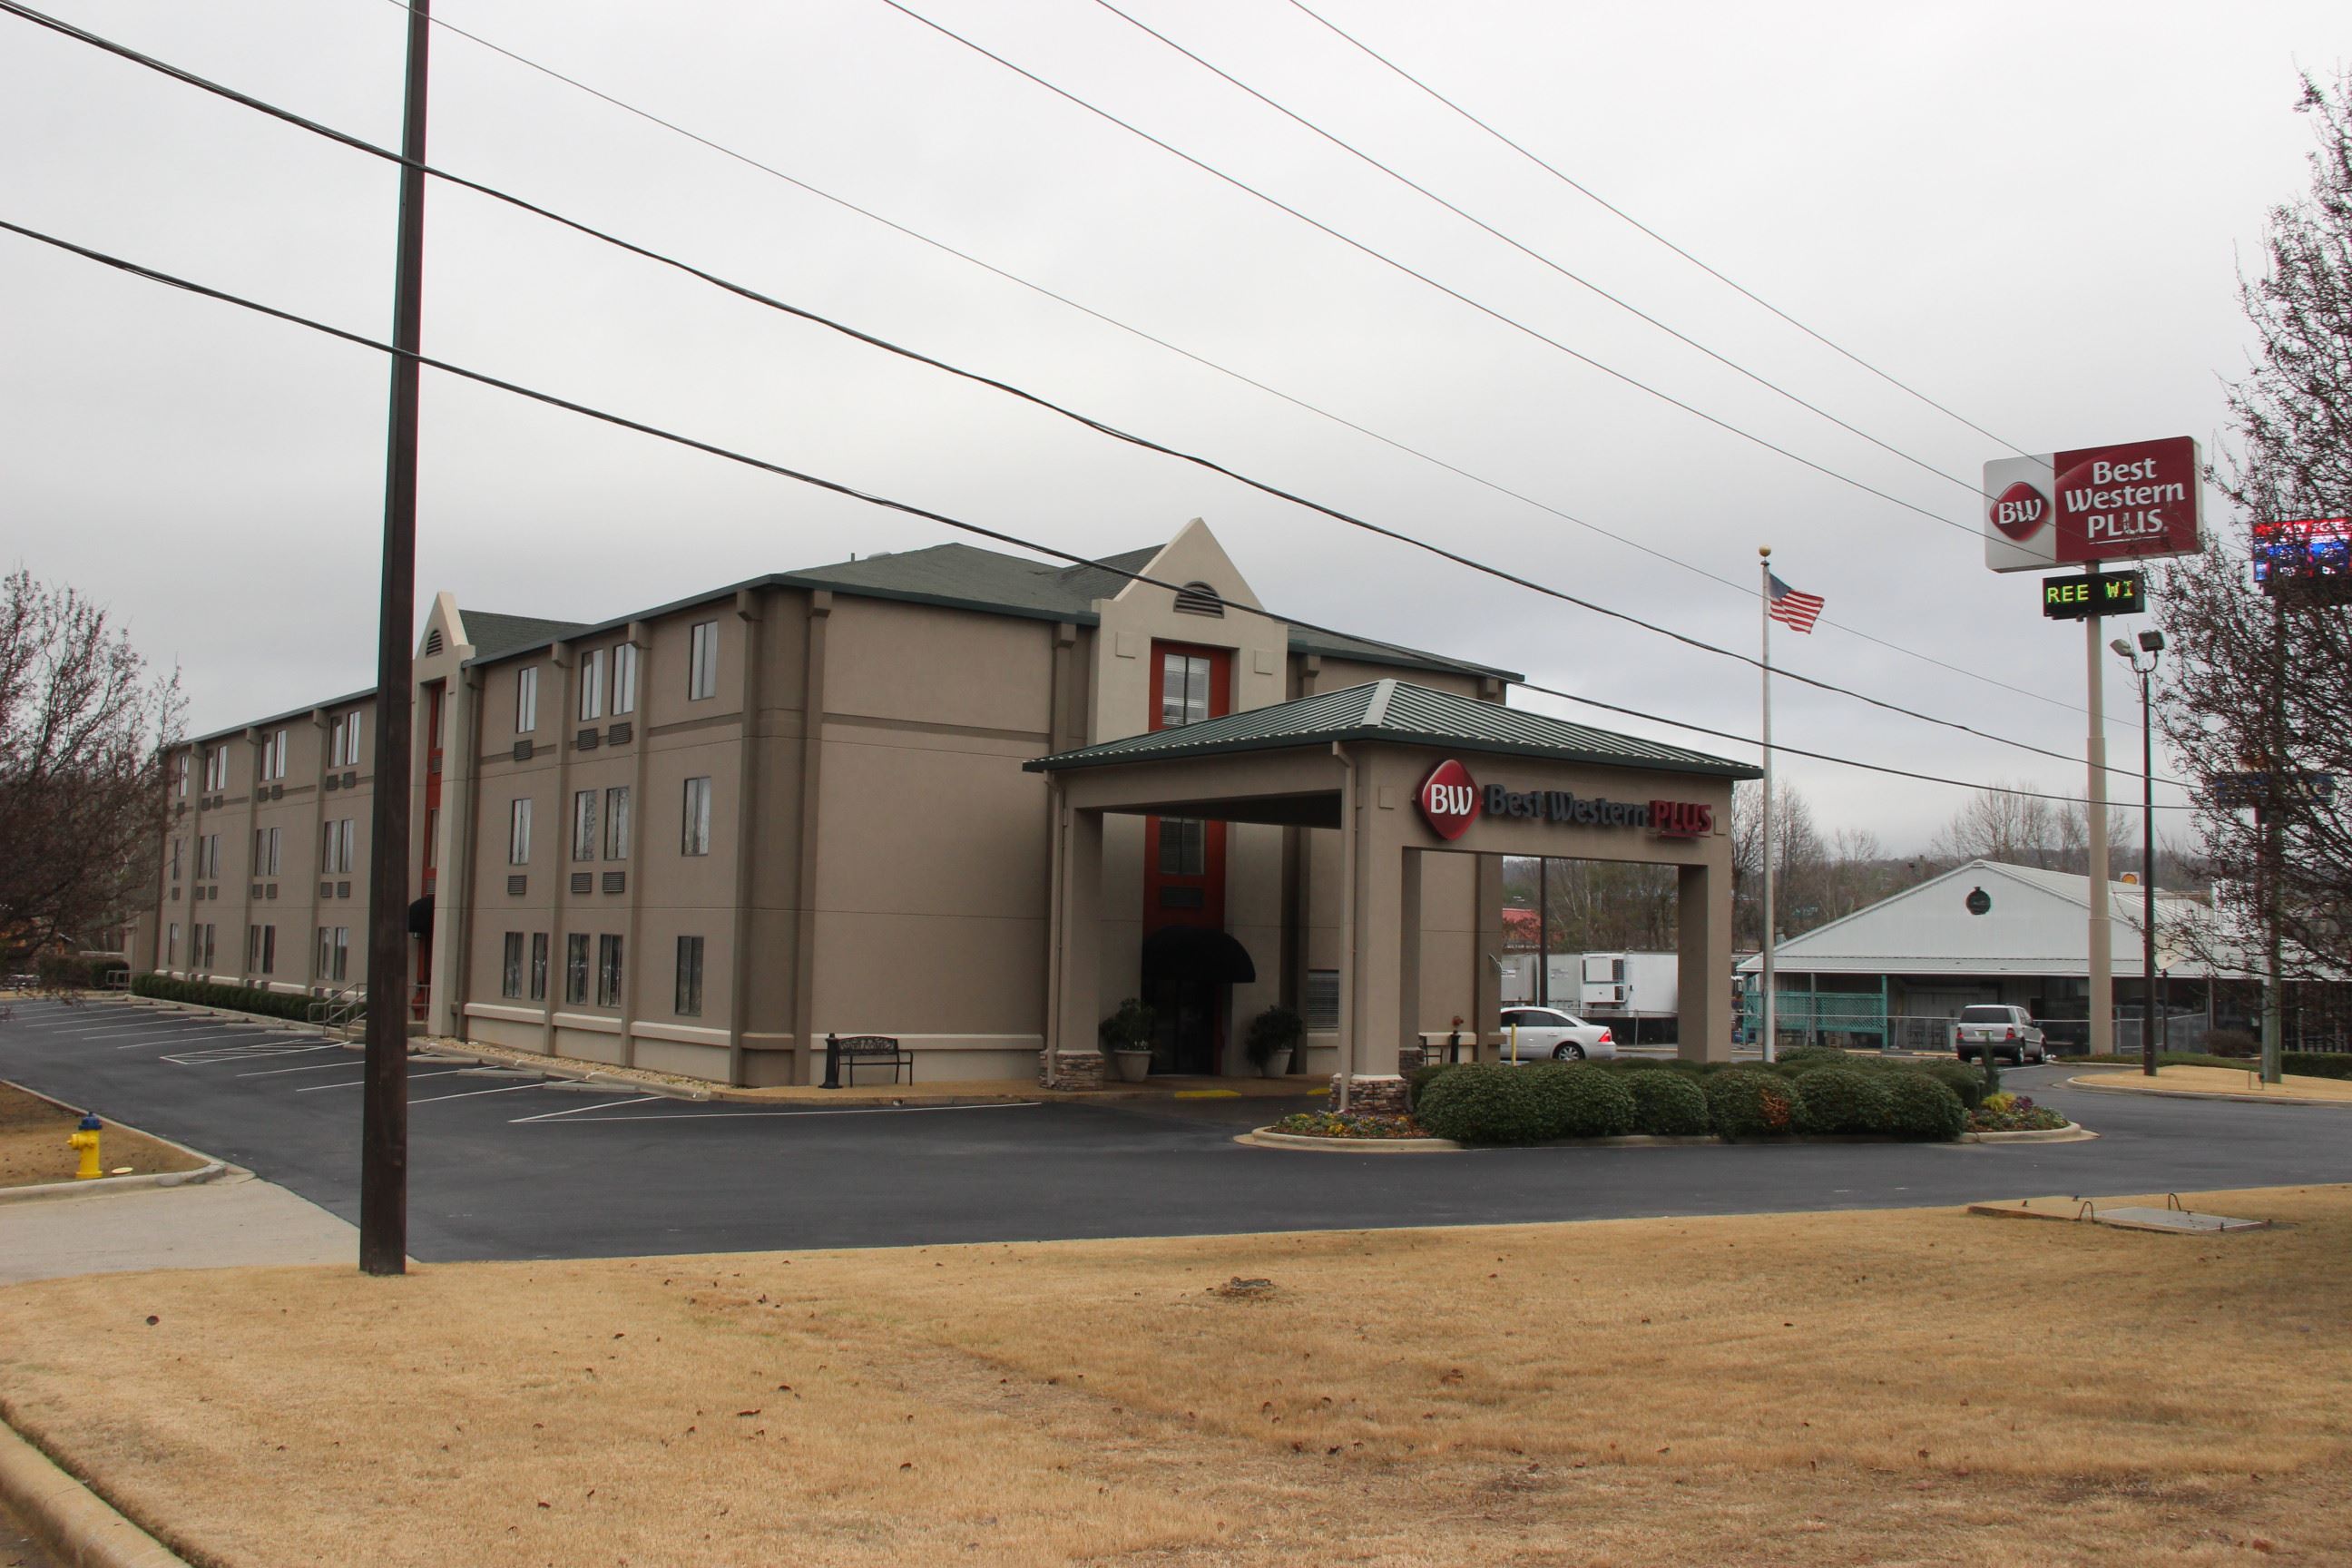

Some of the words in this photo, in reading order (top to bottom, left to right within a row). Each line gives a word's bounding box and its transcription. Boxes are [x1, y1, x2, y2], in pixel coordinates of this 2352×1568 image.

[2092, 457, 2157, 485] Best
[1997, 497, 2042, 524] BW
[2064, 482, 2185, 514] Western
[2088, 508, 2163, 539] PLUS
[2046, 583, 2089, 604] REE
[1430, 783, 1474, 815] BW
[1485, 783, 1545, 817] Best
[1544, 790, 1650, 827] Western
[1649, 799, 1712, 832] PLUS
